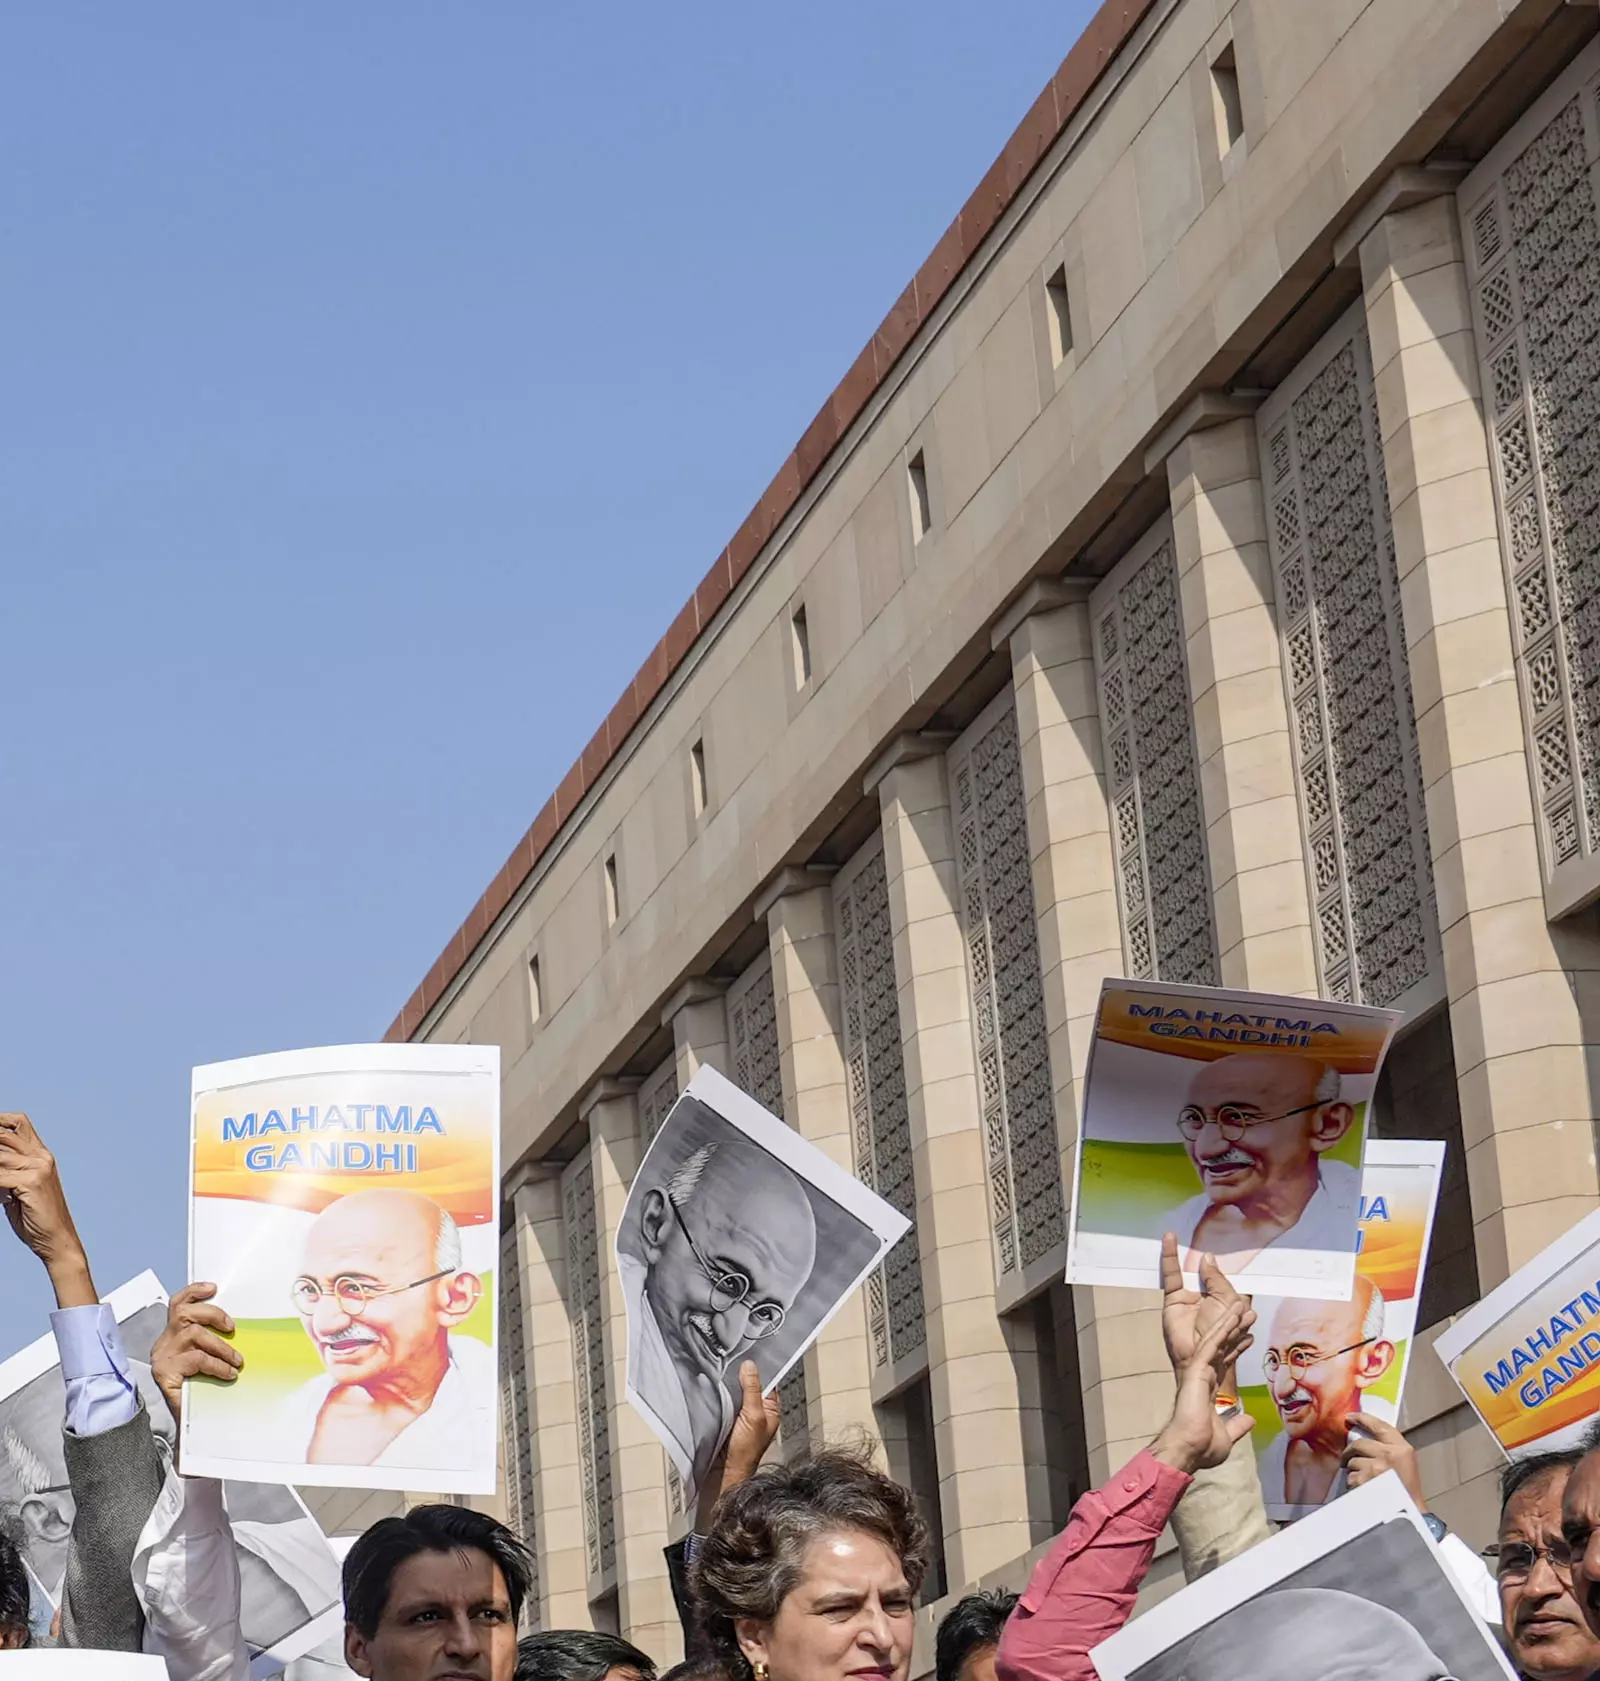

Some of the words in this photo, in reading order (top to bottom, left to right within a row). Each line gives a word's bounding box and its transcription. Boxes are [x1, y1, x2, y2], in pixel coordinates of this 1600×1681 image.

[1128, 1003, 1340, 1035] MAHATMA
[1149, 1022, 1311, 1048] GANDHI
[221, 1104, 447, 1142] MAHATMA
[245, 1141, 418, 1173] GANDHI
[1483, 1280, 1600, 1396] MAHATM
[1519, 1331, 1600, 1408] GAND
